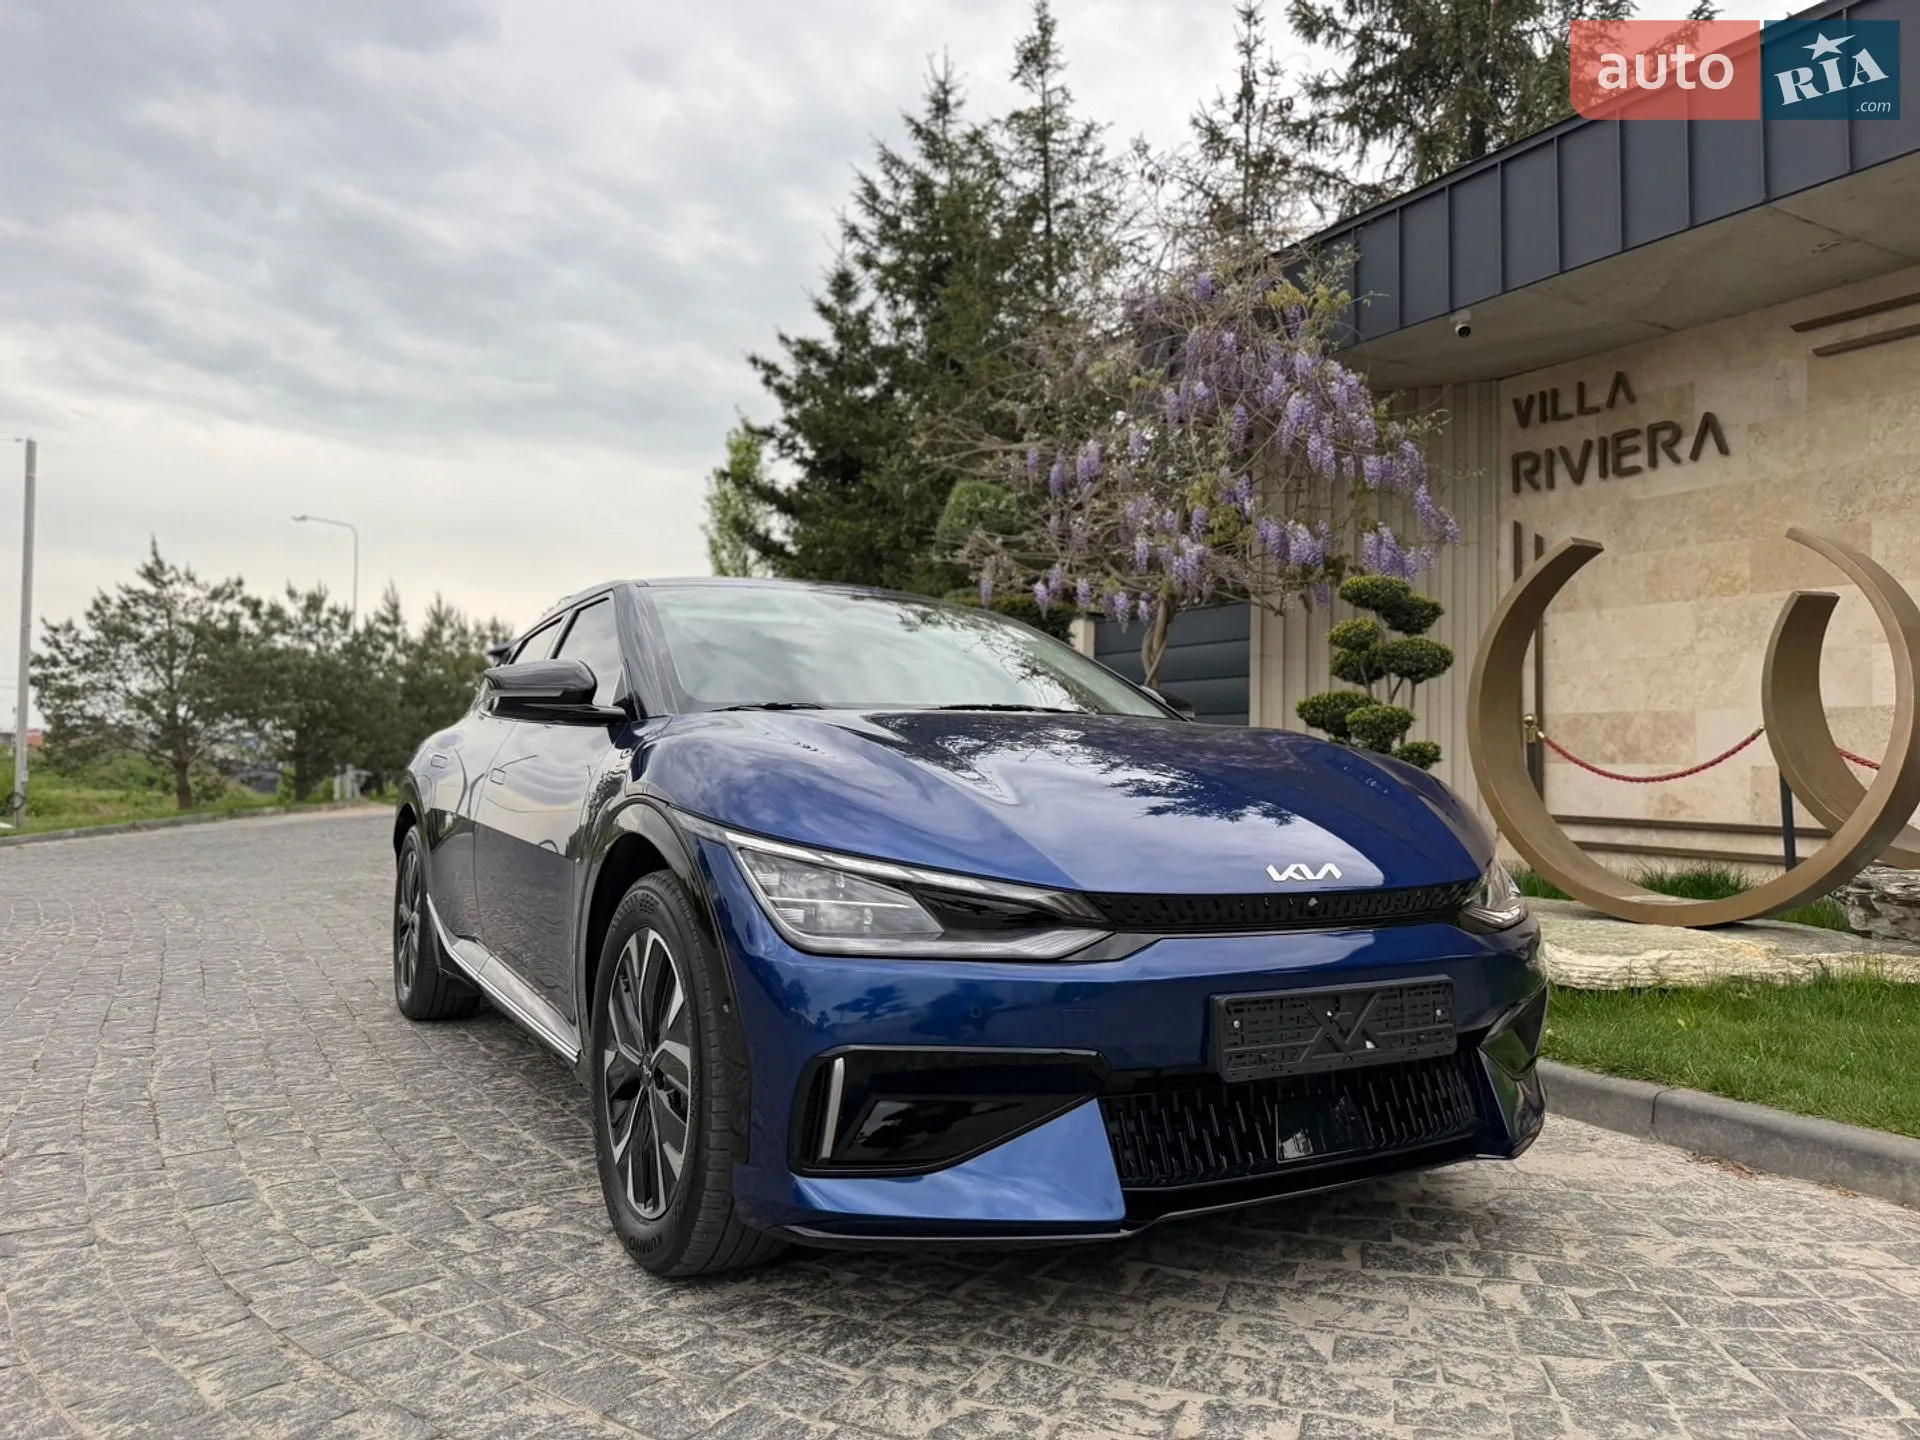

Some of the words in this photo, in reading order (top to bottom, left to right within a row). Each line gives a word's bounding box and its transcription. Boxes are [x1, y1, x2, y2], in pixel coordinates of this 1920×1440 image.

[1511, 370, 1636, 429] VILLA
[1510, 411, 1731, 494] RIVIERA
[1266, 863, 1343, 881] KIA
